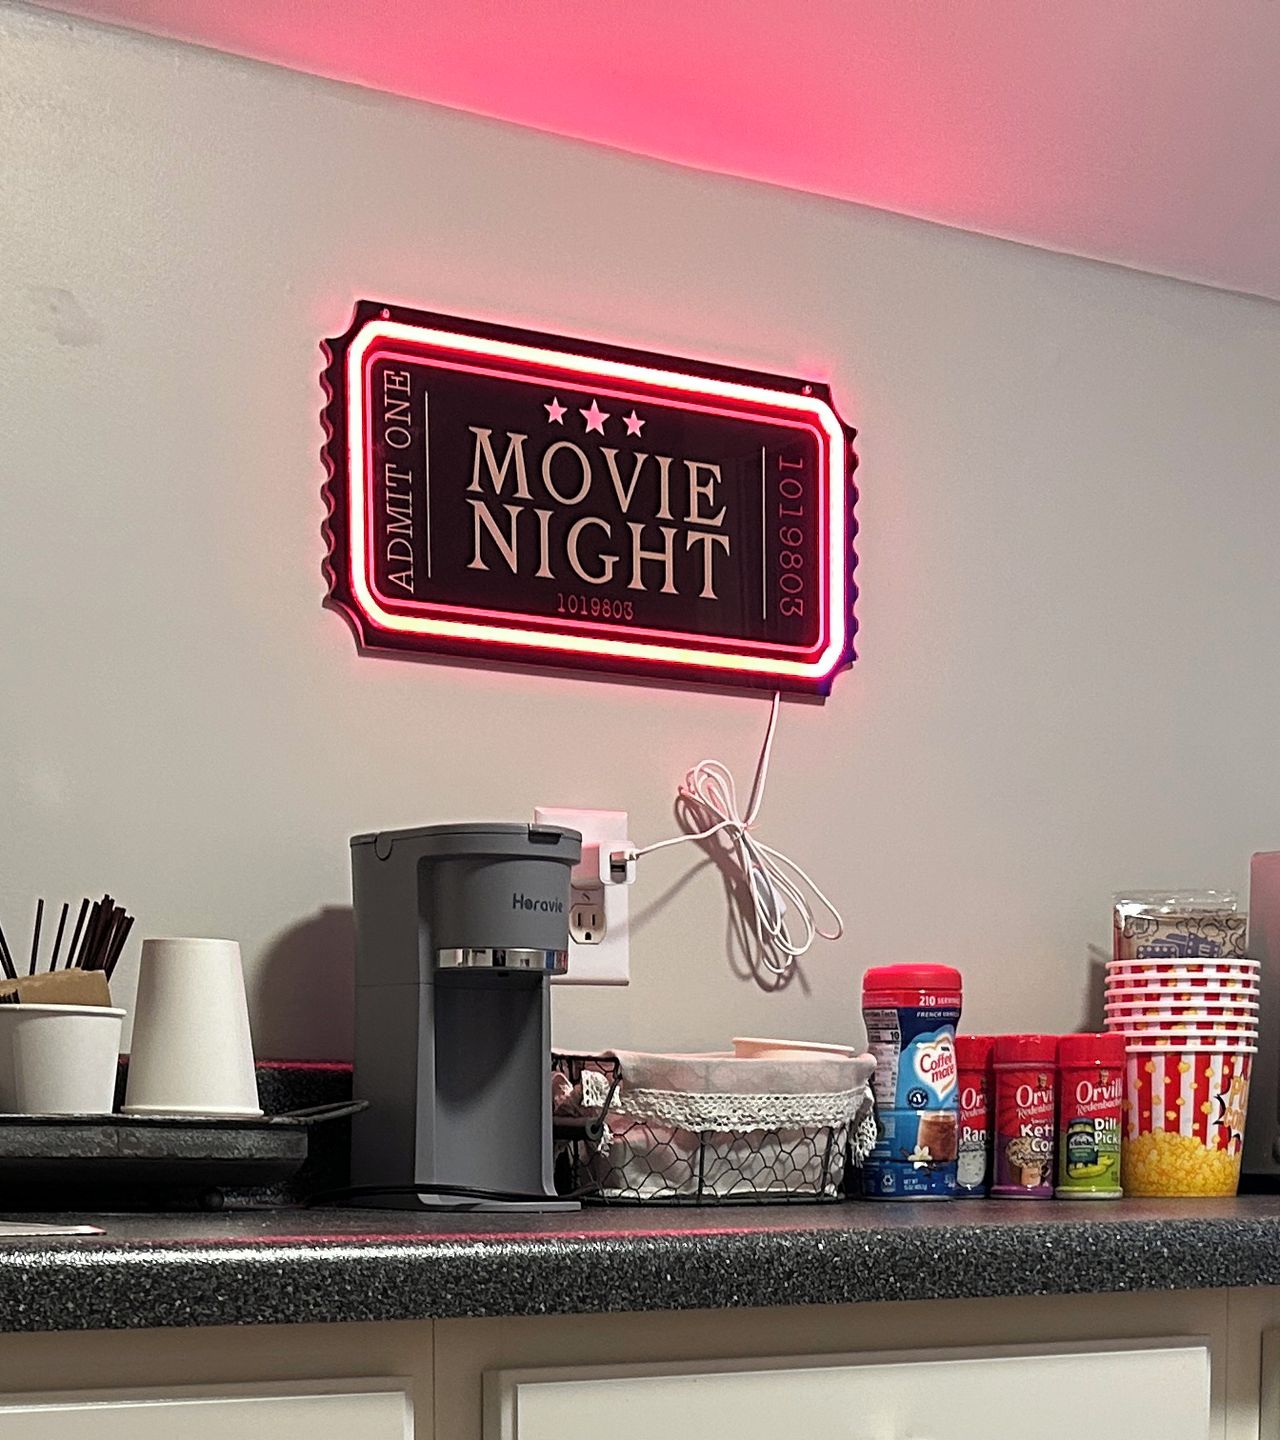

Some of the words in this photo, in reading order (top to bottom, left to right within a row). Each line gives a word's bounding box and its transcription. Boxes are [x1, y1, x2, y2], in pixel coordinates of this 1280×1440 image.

[384, 369, 412, 450] ONE
[466, 425, 728, 528] MOVIE
[385, 463, 414, 594] ADMIT
[466, 498, 731, 600] NIGHT
[778, 454, 804, 617] 1019803
[557, 592, 634, 621] 1019803
[918, 995, 936, 1007] 210
[890, 1030, 900, 1041] 10
[920, 1053, 952, 1073] Coffee
[1094, 1117, 1117, 1131] Dill
